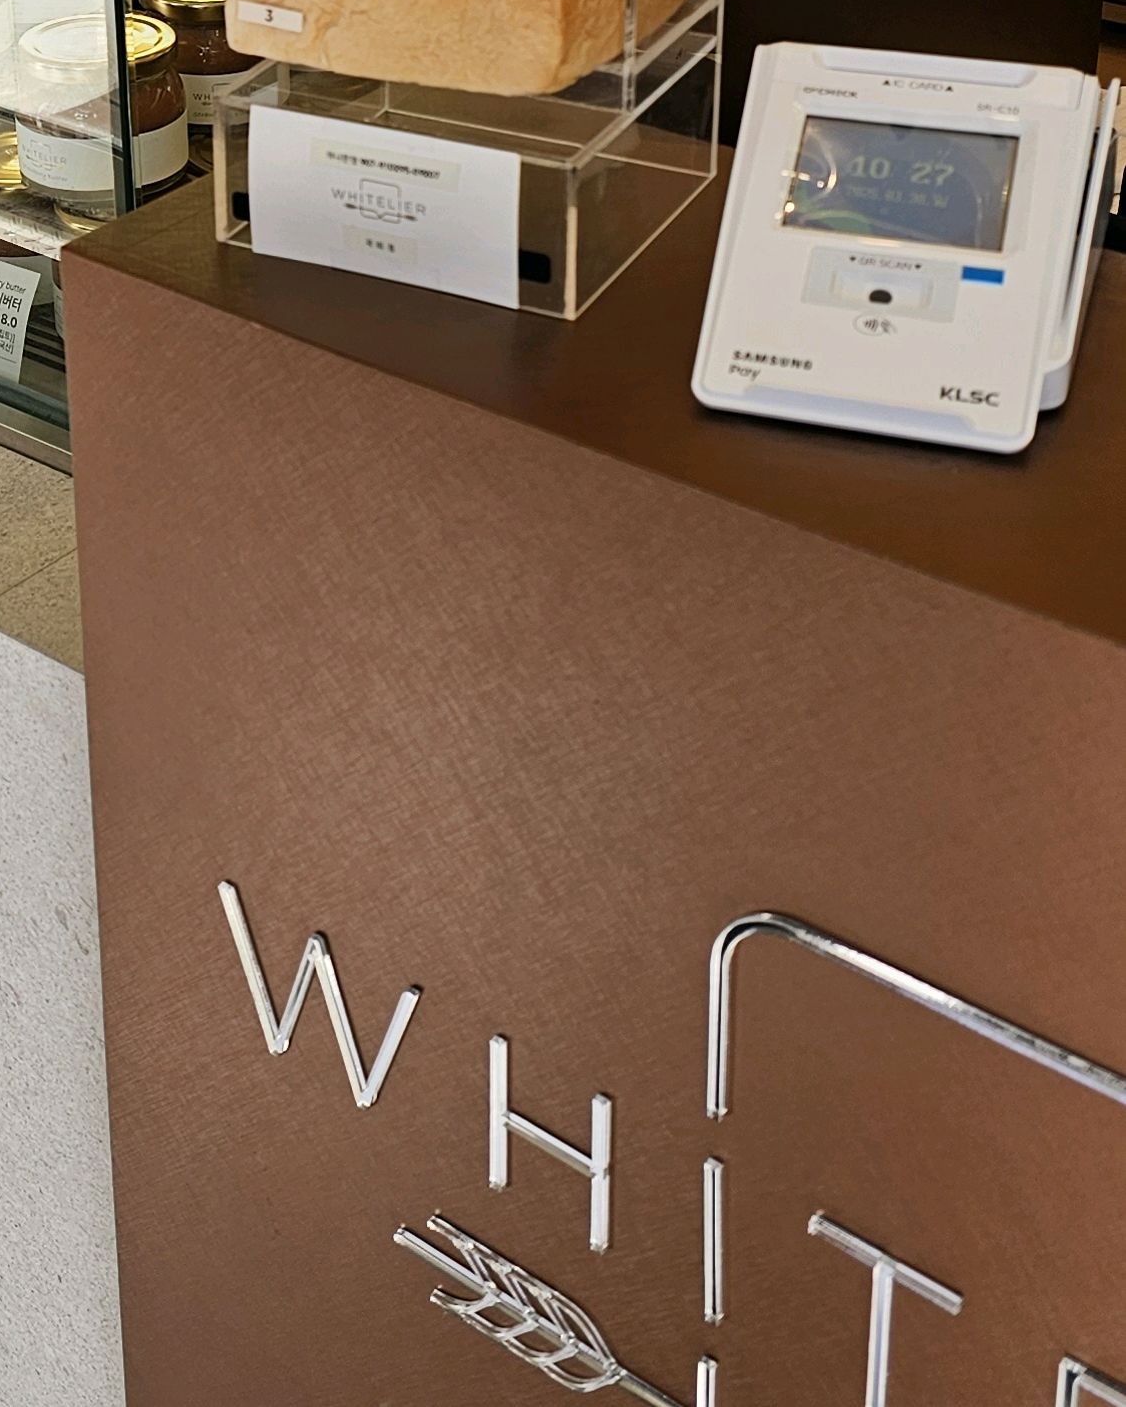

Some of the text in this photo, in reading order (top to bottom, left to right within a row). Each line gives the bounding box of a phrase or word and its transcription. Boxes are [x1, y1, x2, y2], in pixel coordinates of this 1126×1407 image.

[264, 8, 274, 23] 3
[850, 155, 954, 187] 10 27
[331, 187, 427, 216] WHITELIER
[6, 281, 26, 294] butter
[1, 313, 18, 328] 8.0
[733, 350, 813, 371] SAMSUNG
[728, 365, 762, 381] Pay
[939, 386, 1001, 407] KLSC
